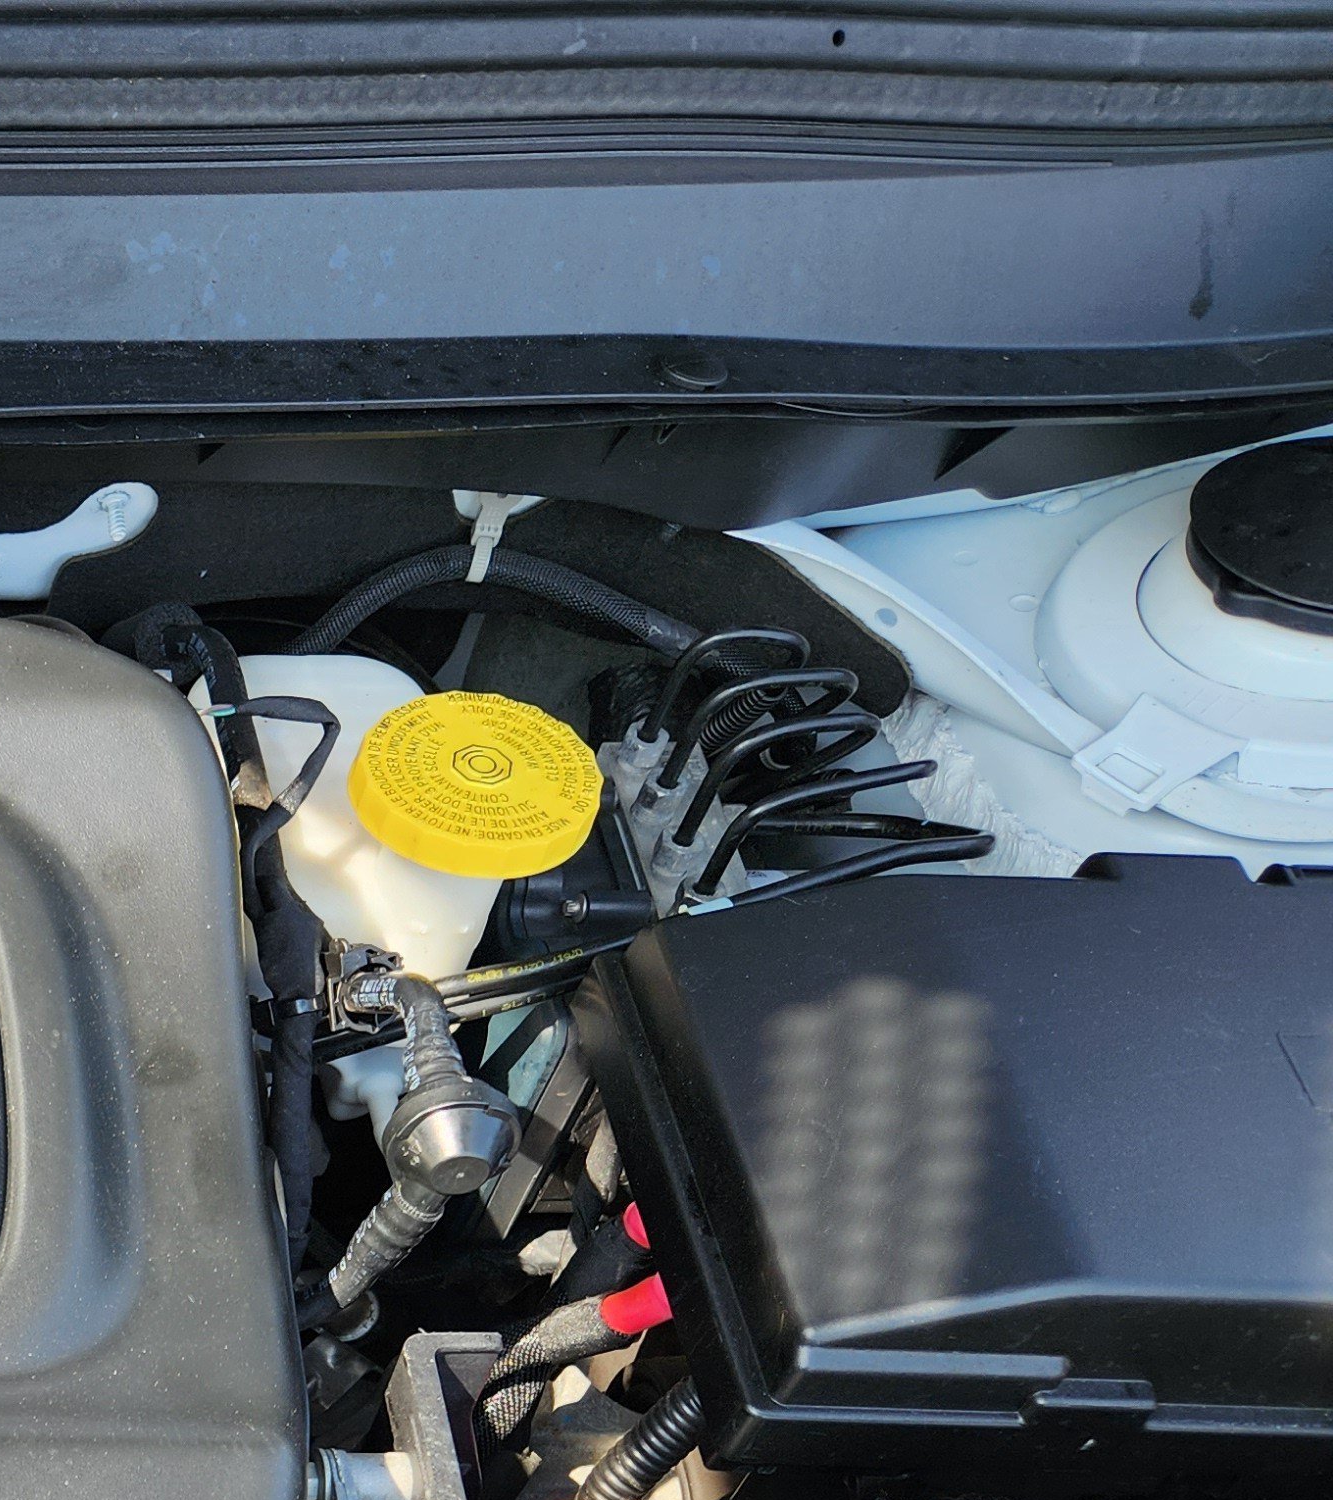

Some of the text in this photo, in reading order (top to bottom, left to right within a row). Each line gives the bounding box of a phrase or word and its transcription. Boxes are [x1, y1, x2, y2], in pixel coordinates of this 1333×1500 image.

[446, 692, 520, 710] CONTAINER
[461, 704, 494, 716] ONLY
[498, 709, 524, 724] USE
[387, 710, 434, 756] UNIQUEMENT
[404, 736, 430, 788] PROVENANT
[481, 718, 560, 782] CLEAN FILLER CAP
[491, 730, 540, 770] WARNING:
[567, 739, 593, 763] FROM
[368, 698, 571, 841] MISE EN GARDE: NETTOYER LE BOUCHON DE REMPLISSAGE
[386, 757, 415, 795] UTILISER
[582, 764, 597, 788] FLUID
[425, 786, 437, 795] 3
[429, 774, 510, 804] CONTENANT
[558, 766, 578, 800] BEFORE
[433, 793, 461, 810] DOT
[464, 803, 519, 817] LIQUIDE
[470, 817, 486, 827] LE
[490, 819, 508, 829] DE
[513, 810, 550, 828] AVANT
